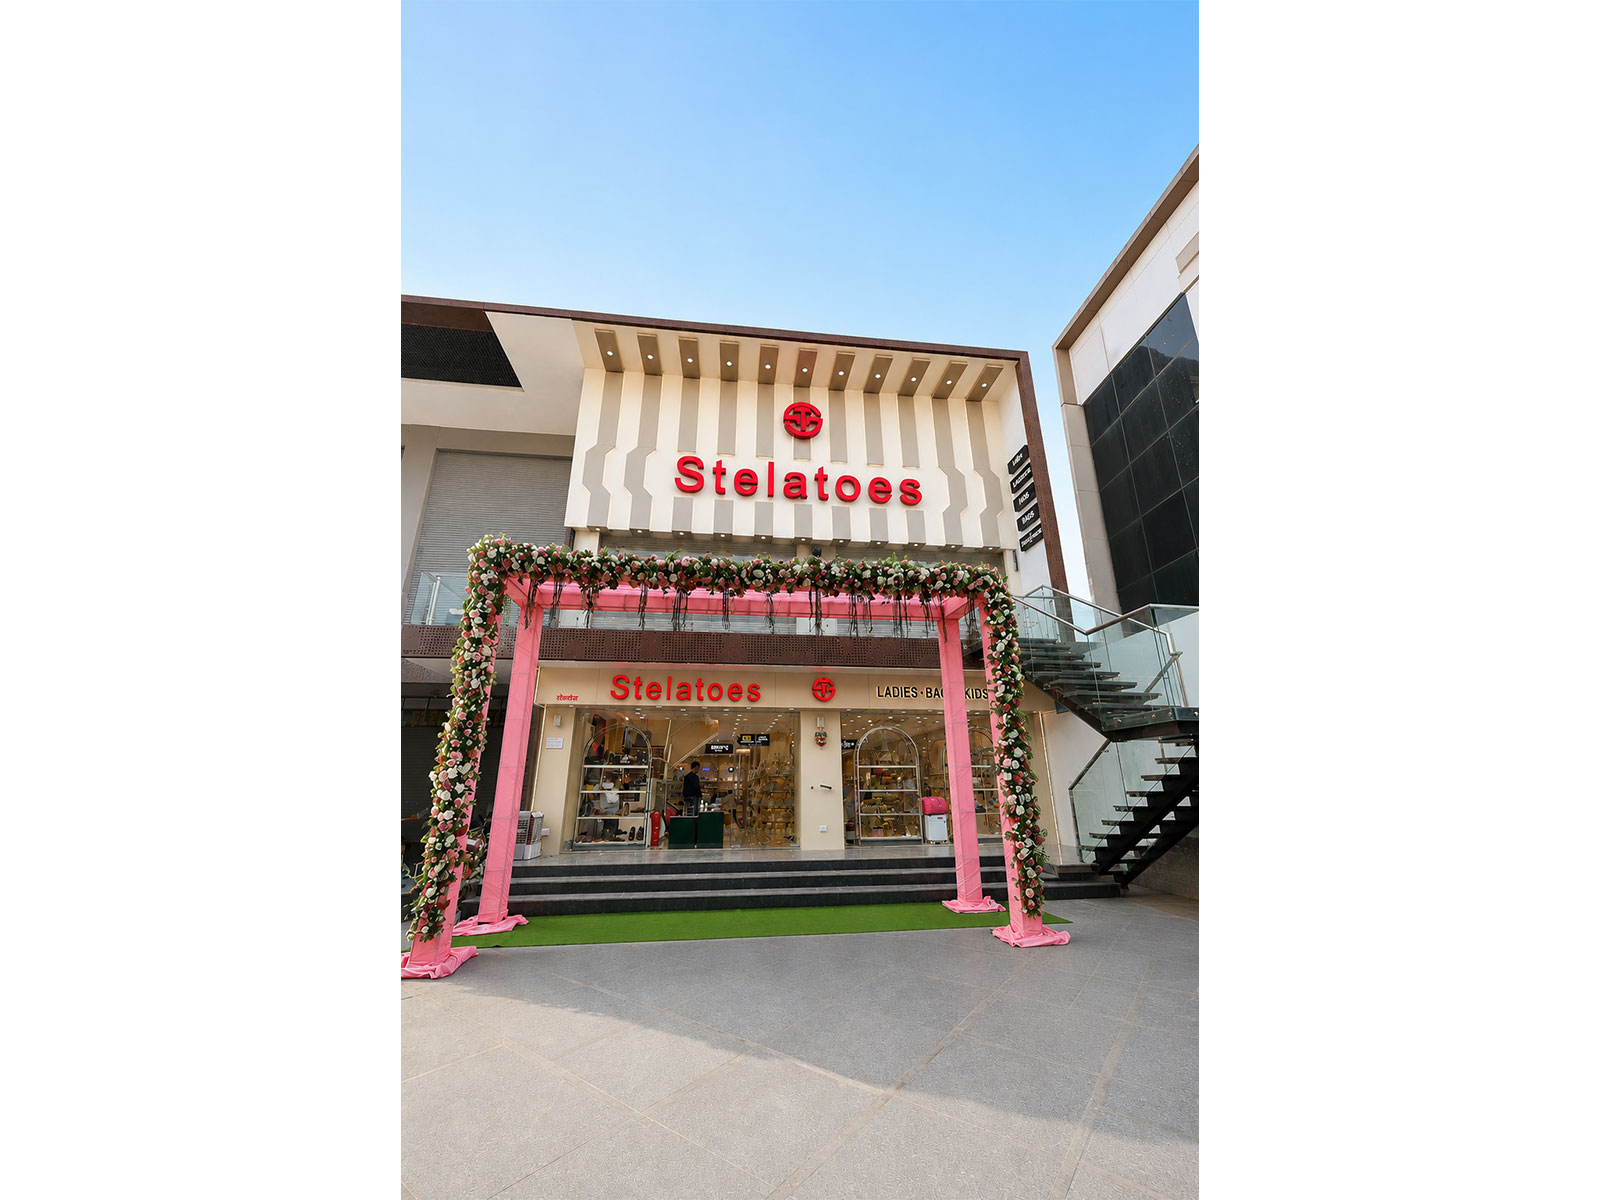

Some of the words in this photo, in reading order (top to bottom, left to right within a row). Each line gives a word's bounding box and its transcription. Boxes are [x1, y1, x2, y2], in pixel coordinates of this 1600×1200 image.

[674, 455, 923, 506] Stelatoes
[611, 674, 762, 702] Stelatoes
[876, 686, 918, 699] LADIES
[965, 688, 989, 700] KIDS
